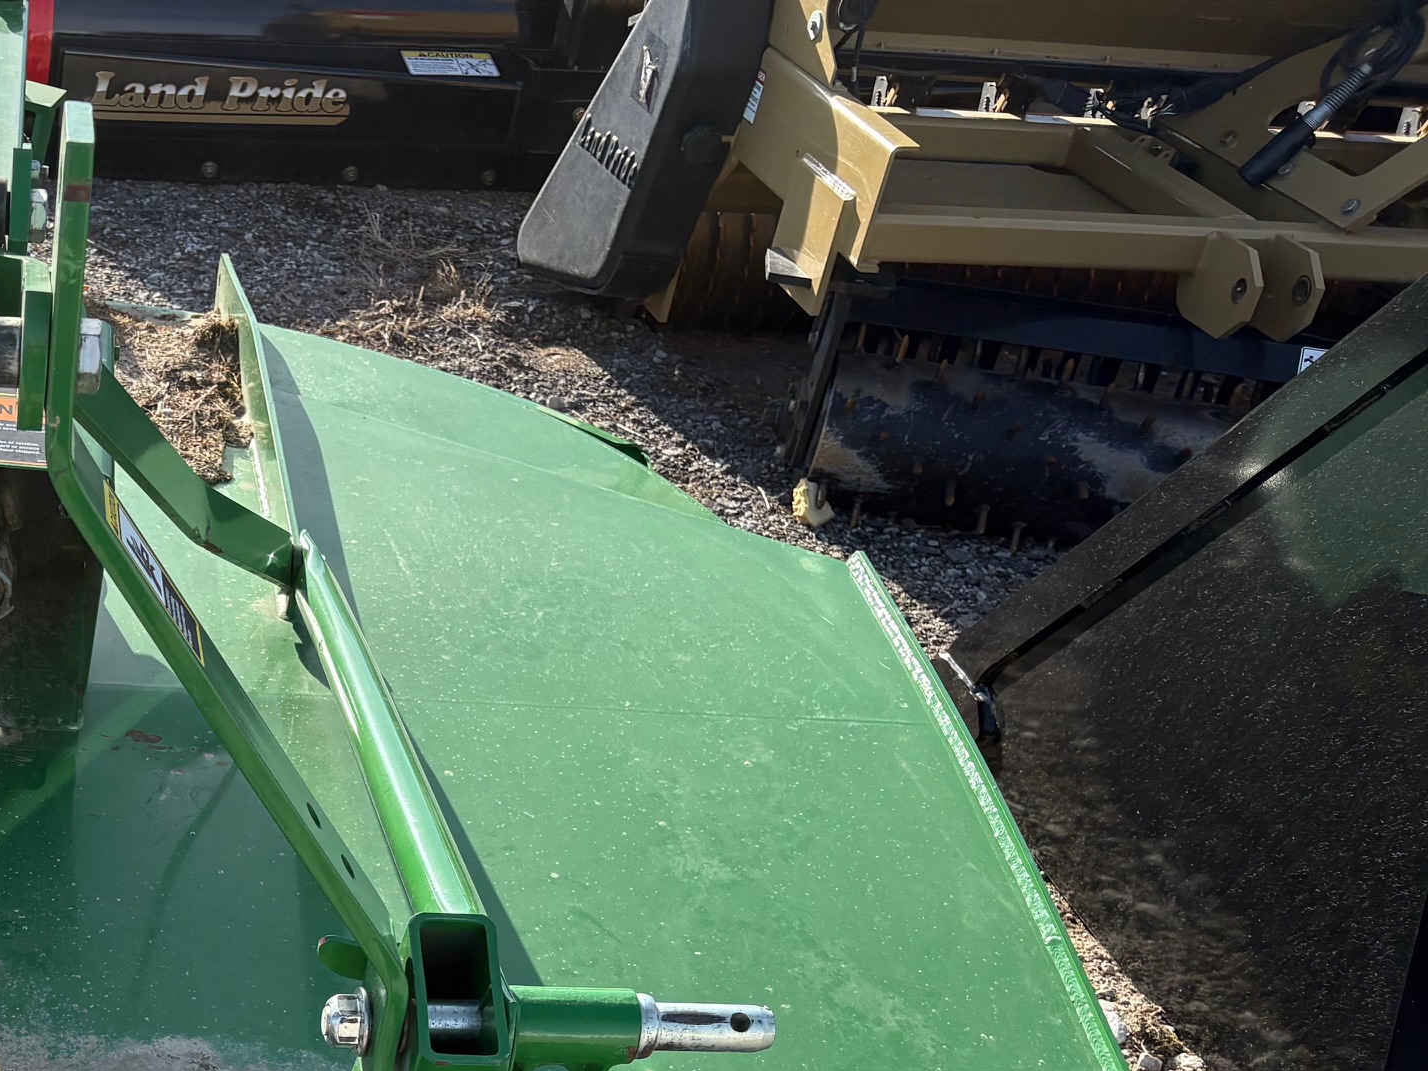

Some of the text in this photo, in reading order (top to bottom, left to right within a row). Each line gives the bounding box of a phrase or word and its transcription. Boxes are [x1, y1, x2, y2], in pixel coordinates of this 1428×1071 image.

[91, 71, 347, 113] Land Pride
[577, 113, 638, 188] Land Pride
